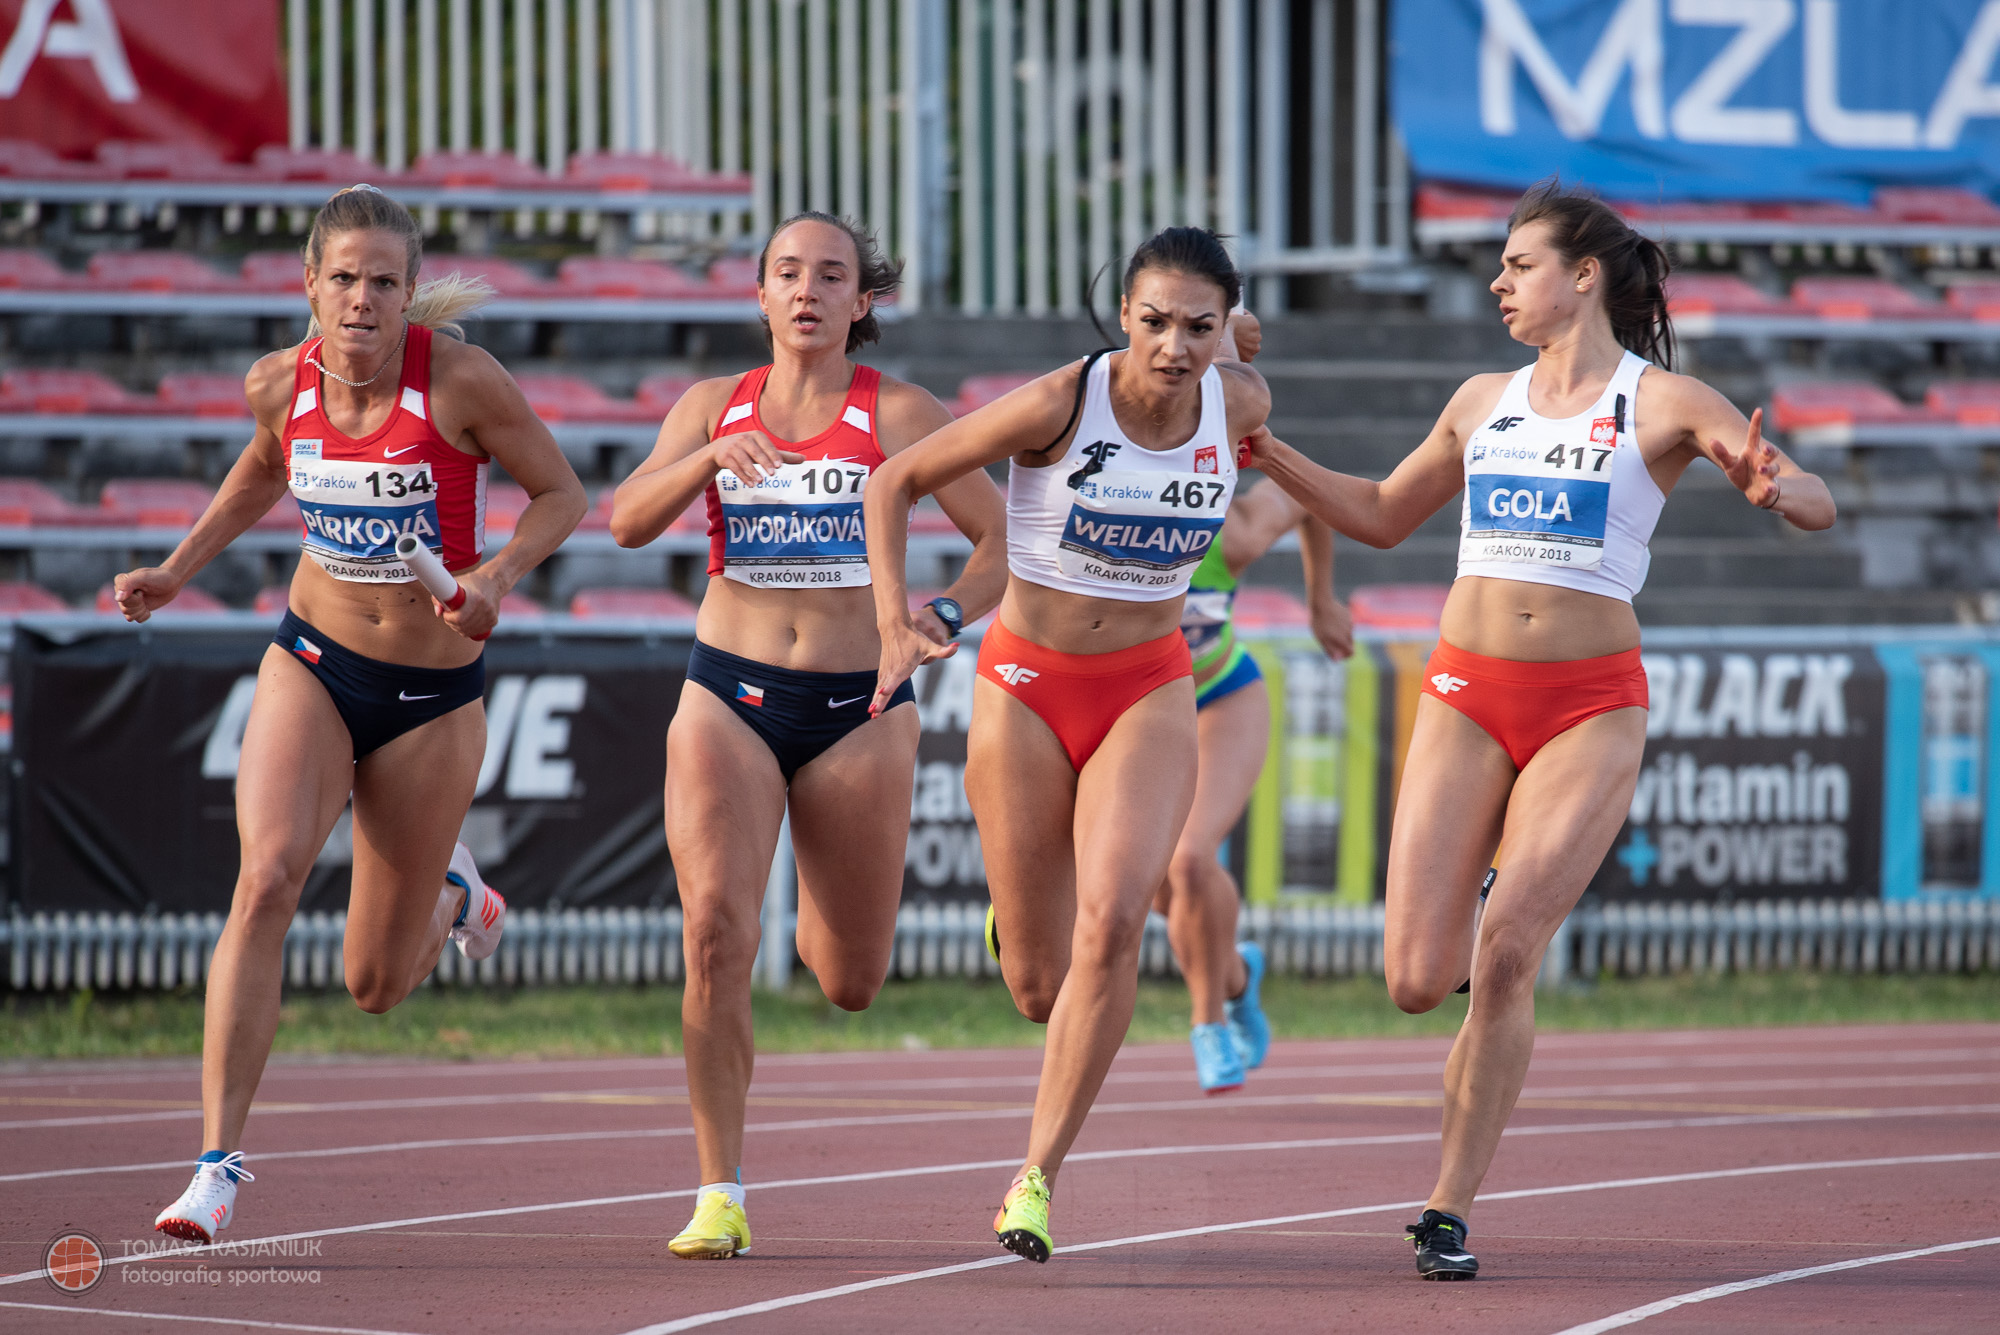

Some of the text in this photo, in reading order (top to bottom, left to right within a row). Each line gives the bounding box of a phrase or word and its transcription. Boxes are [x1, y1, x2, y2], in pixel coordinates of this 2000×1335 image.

[1081, 440, 1122, 462] 4F
[1490, 443, 1612, 472] Kraków 417
[312, 470, 432, 498] Kraków 134
[801, 468, 866, 495] 107
[1102, 480, 1225, 508] Kraków 467
[1488, 487, 1573, 522] GOLA
[301, 508, 436, 546] PÍRKOVÁ
[727, 509, 865, 544] DVORÁKOVÁ
[1074, 514, 1213, 554] WEILAND
[1482, 542, 1572, 561] KRAKÓW 2018
[324, 562, 414, 578] KRAKÓW 2018
[750, 569, 841, 583] KRAKÓW 2018
[1083, 562, 1177, 585] KRAKÓW 2018
[994, 663, 1040, 686] 4F
[1431, 672, 1469, 695] 4F
[1638, 653, 1853, 738] BLACK
[1626, 750, 1850, 825] vitamin
